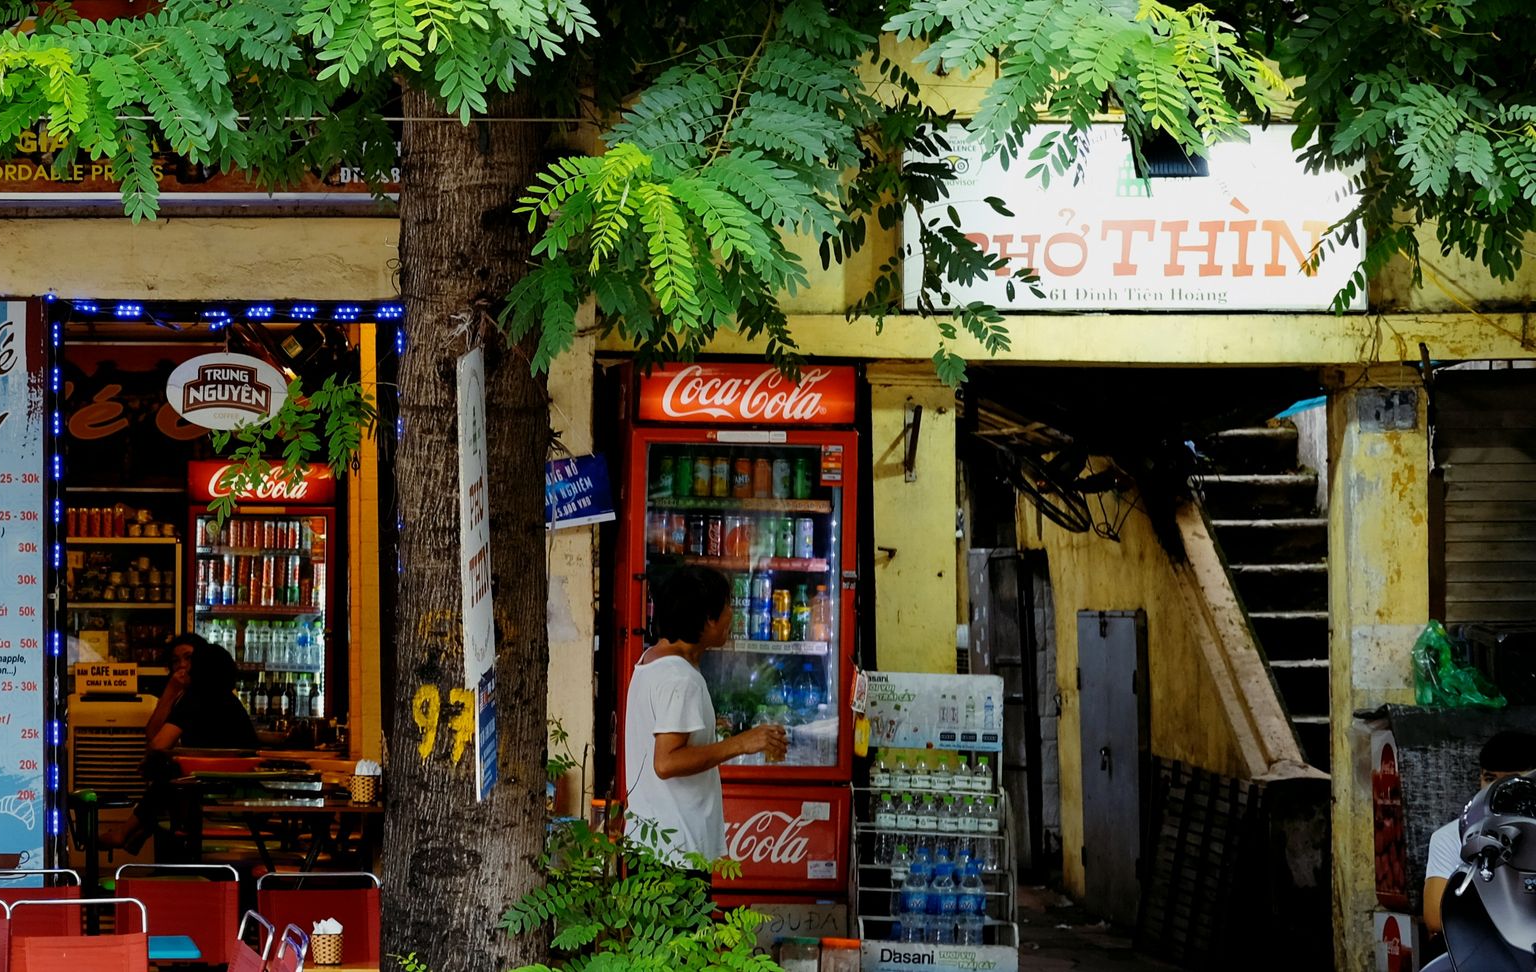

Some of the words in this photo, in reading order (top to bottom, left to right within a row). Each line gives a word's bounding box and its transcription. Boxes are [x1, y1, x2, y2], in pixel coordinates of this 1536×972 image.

[1100, 196, 1325, 278] THÌN
[204, 368, 249, 382] TRUNG
[189, 382, 267, 405] NGUYÊN
[213, 411, 241, 420] COFFEE
[0, 473, 12, 484] 25
[21, 473, 40, 484] 30k
[20, 511, 39, 521] 30k
[18, 543, 38, 553] 30k
[17, 575, 37, 585] 30k
[18, 606, 36, 617] 50k
[19, 638, 38, 648] 50k
[90, 666, 110, 676] CAFE
[1, 681, 13, 692] 25
[21, 681, 38, 691] 30k
[21, 728, 40, 739] 25k
[19, 760, 38, 770] 20k
[17, 790, 36, 800] 20k
[879, 949, 935, 965] Dasani
